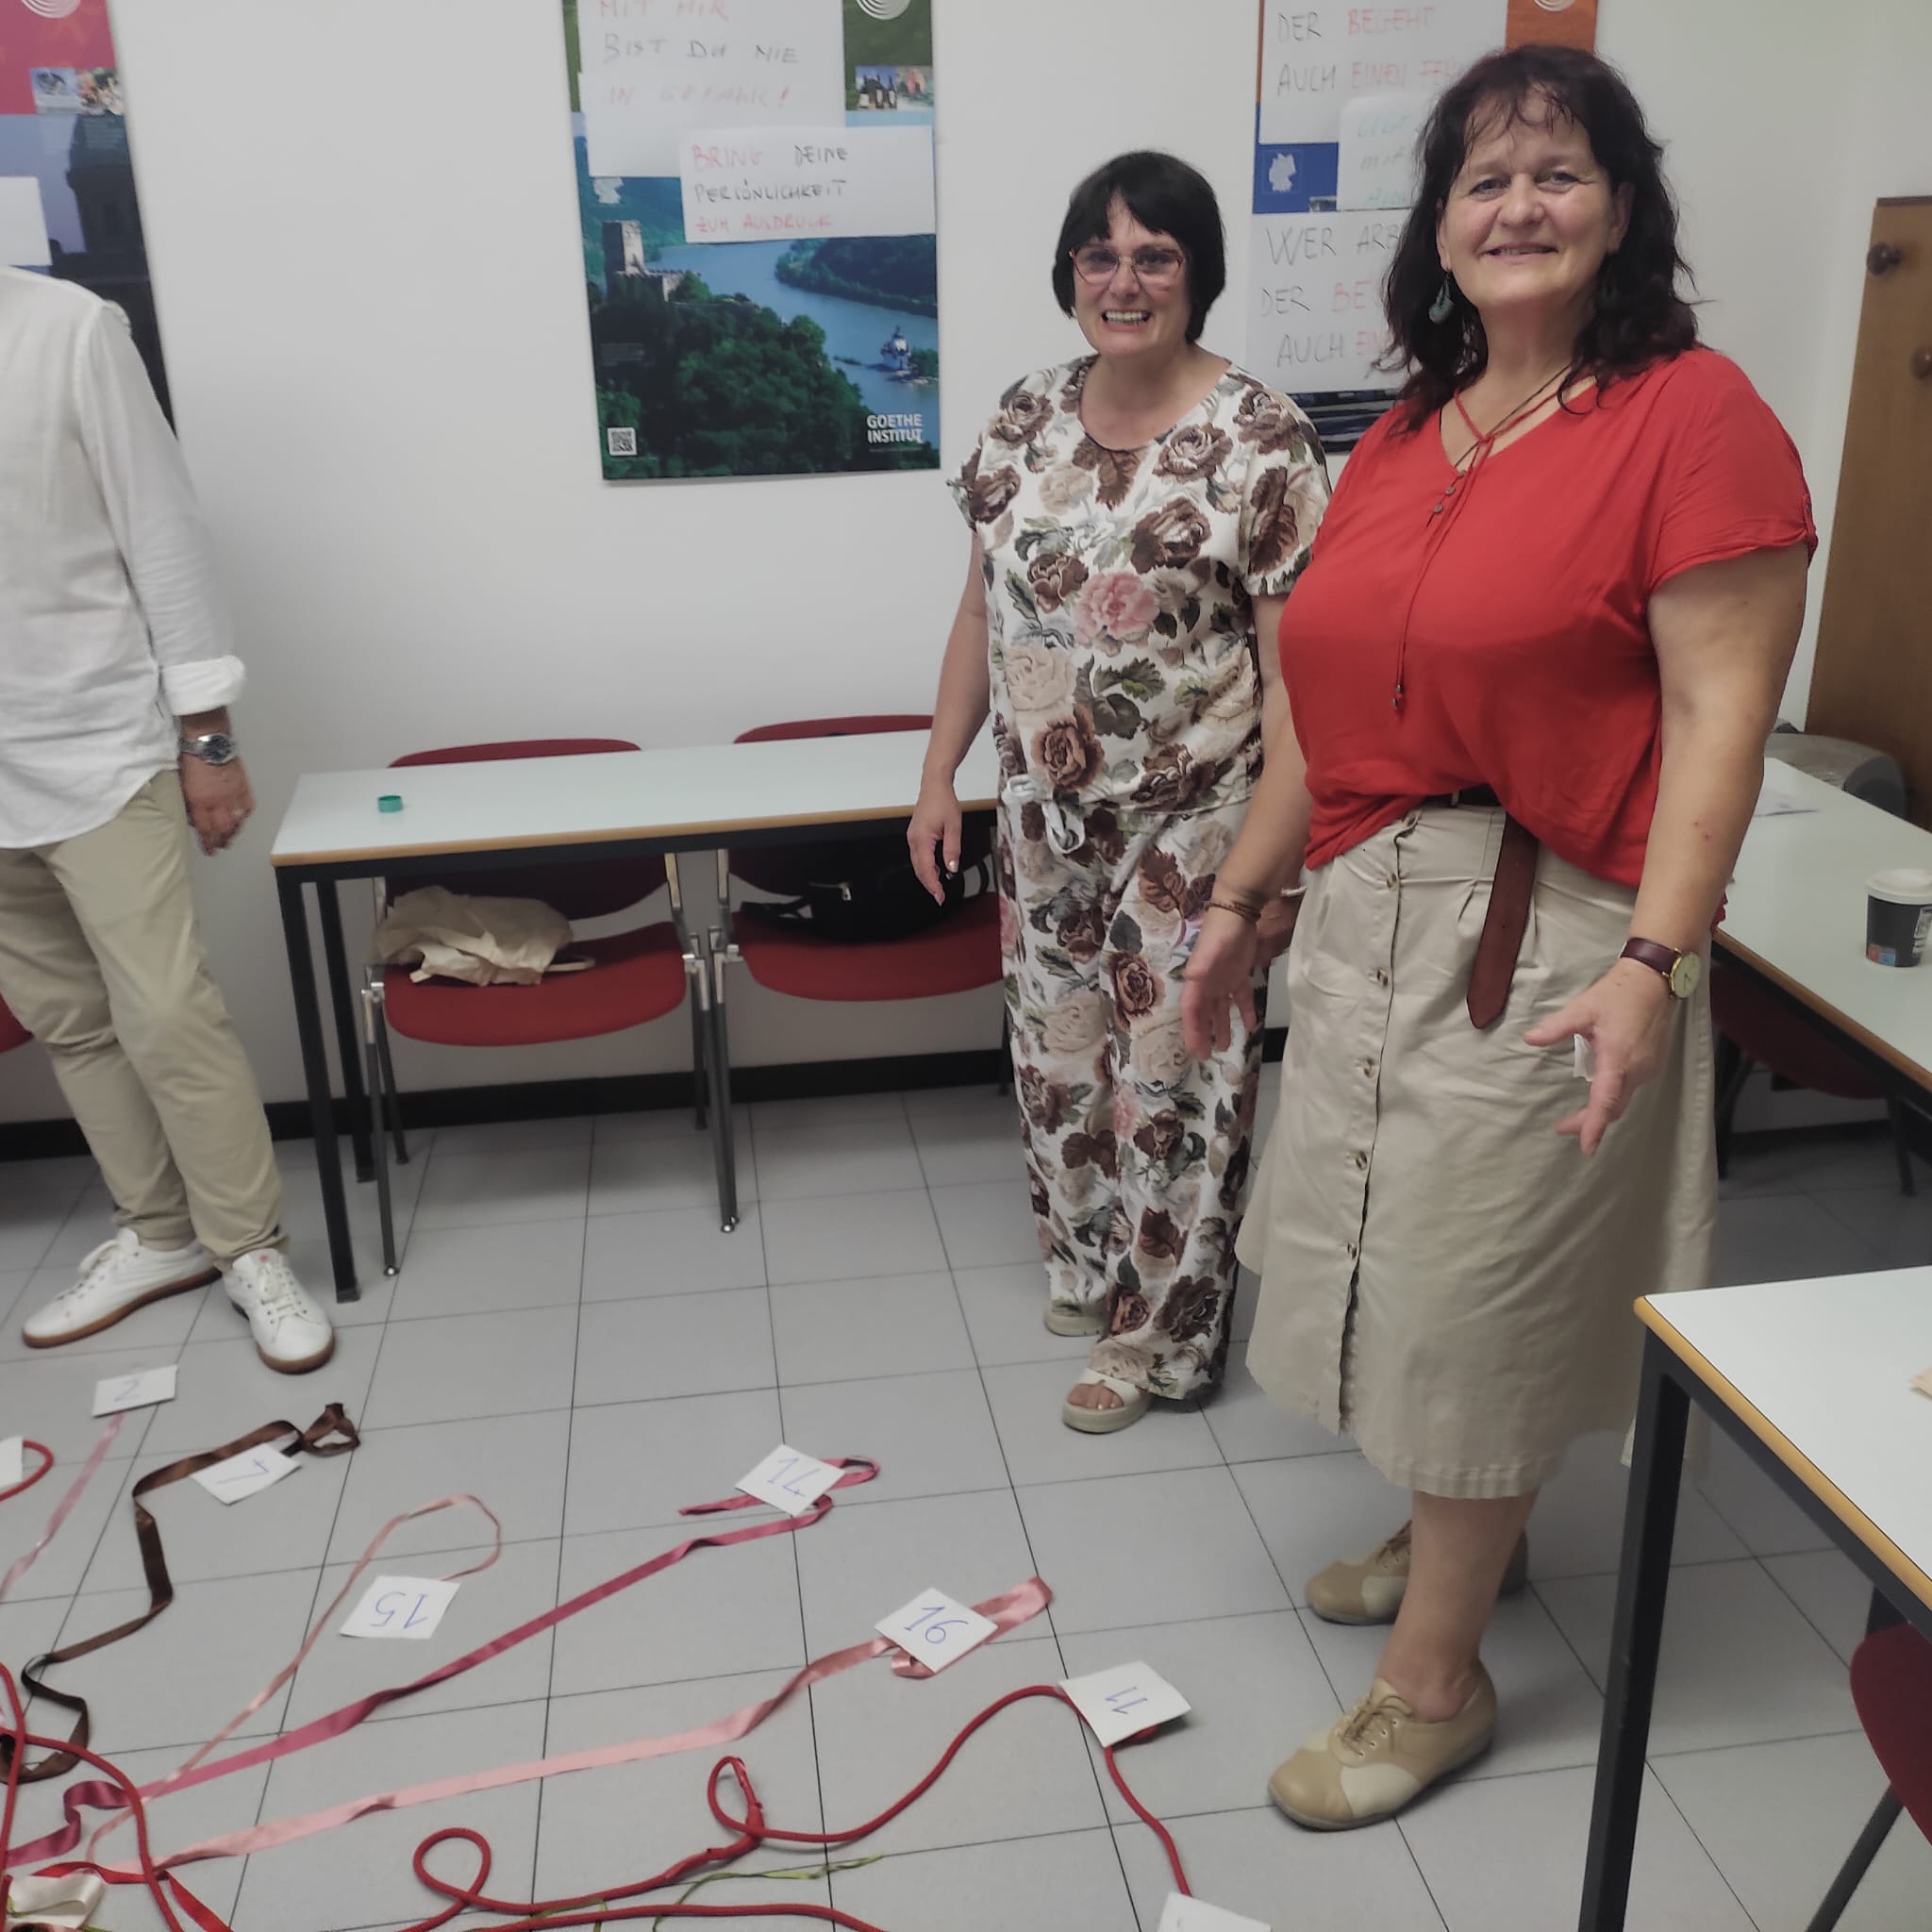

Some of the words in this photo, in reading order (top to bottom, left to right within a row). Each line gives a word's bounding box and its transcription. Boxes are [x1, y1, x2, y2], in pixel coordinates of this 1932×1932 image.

[1277, 11, 1321, 43] DER
[1348, 7, 1436, 36] BEGEHT
[603, 33, 668, 63] BIST
[687, 39, 727, 59] DU
[755, 44, 800, 64] NIE
[1277, 64, 1336, 96] AUCH
[1352, 61, 1407, 90] EINEN
[691, 144, 763, 170] BRING
[696, 214, 730, 233] ZUM
[1266, 226, 1337, 265] WER
[1261, 285, 1310, 317] DER
[1276, 333, 1343, 367] AUCH
[866, 413, 922, 428] GOETHE
[867, 428, 922, 443] INSTITUT
[113, 1378, 141, 1402] 2
[766, 1457, 821, 1498] 14
[369, 1590, 429, 1630] 15
[903, 1605, 969, 1644] 16
[1104, 1686, 1148, 1715] 11
